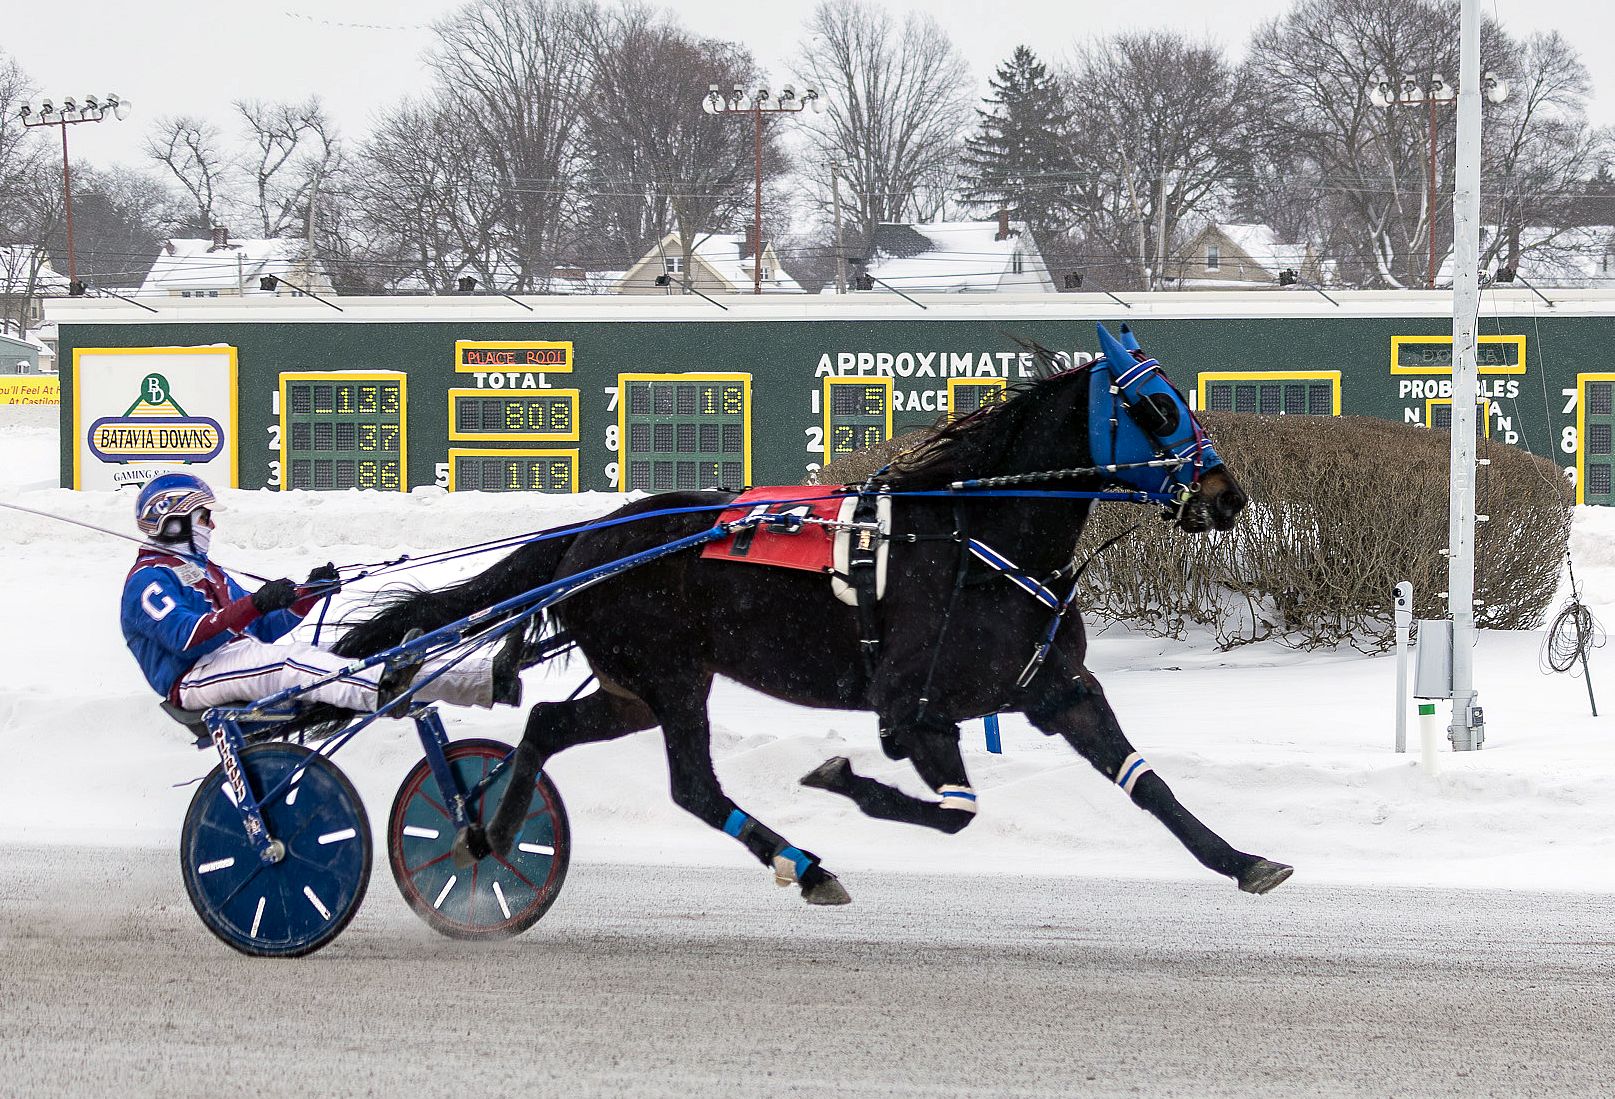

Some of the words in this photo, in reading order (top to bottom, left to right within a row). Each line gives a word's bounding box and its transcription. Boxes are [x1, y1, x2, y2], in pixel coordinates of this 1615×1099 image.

[467, 352, 515, 364] PLACE
[815, 351, 1034, 378] APPROXIMATE
[21, 385, 40, 395] Feel
[42, 385, 53, 395] At
[473, 373, 552, 389] TOTAL
[1399, 379, 1520, 399] PROBLES
[604, 386, 619, 412] 7
[704, 387, 742, 414] 18
[865, 387, 883, 415] 5
[892, 389, 948, 412] RACE
[1562, 388, 1578, 414] 7
[506, 403, 569, 429] 808
[100, 429, 155, 449] BATAVIA
[159, 429, 213, 449] DOWNS
[266, 425, 281, 450] 2
[359, 425, 399, 451] 37
[605, 424, 620, 451] 8
[804, 426, 824, 453] 2
[1561, 425, 1578, 454] 8
[113, 469, 152, 482] GAMING
[266, 460, 281, 486] 3
[359, 461, 399, 488] 86
[435, 463, 450, 488] 5
[509, 462, 569, 489] 119
[604, 462, 620, 488] 9
